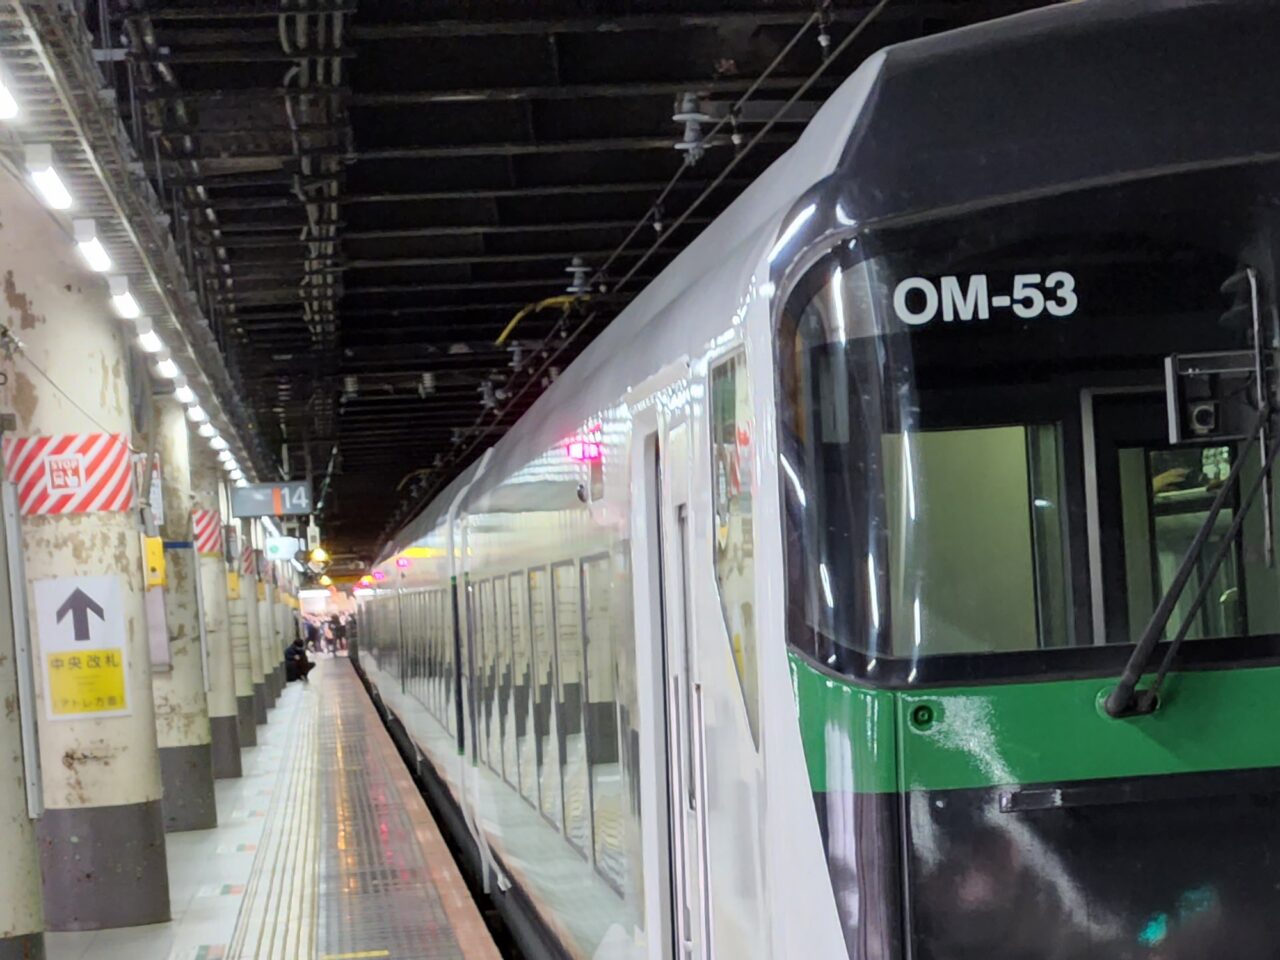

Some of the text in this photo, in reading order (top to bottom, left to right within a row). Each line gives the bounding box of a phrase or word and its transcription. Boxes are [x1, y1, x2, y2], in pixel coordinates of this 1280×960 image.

[893, 271, 1078, 325] OM-53
[281, 486, 309, 509] 14
[50, 653, 119, 669] 中央改札
